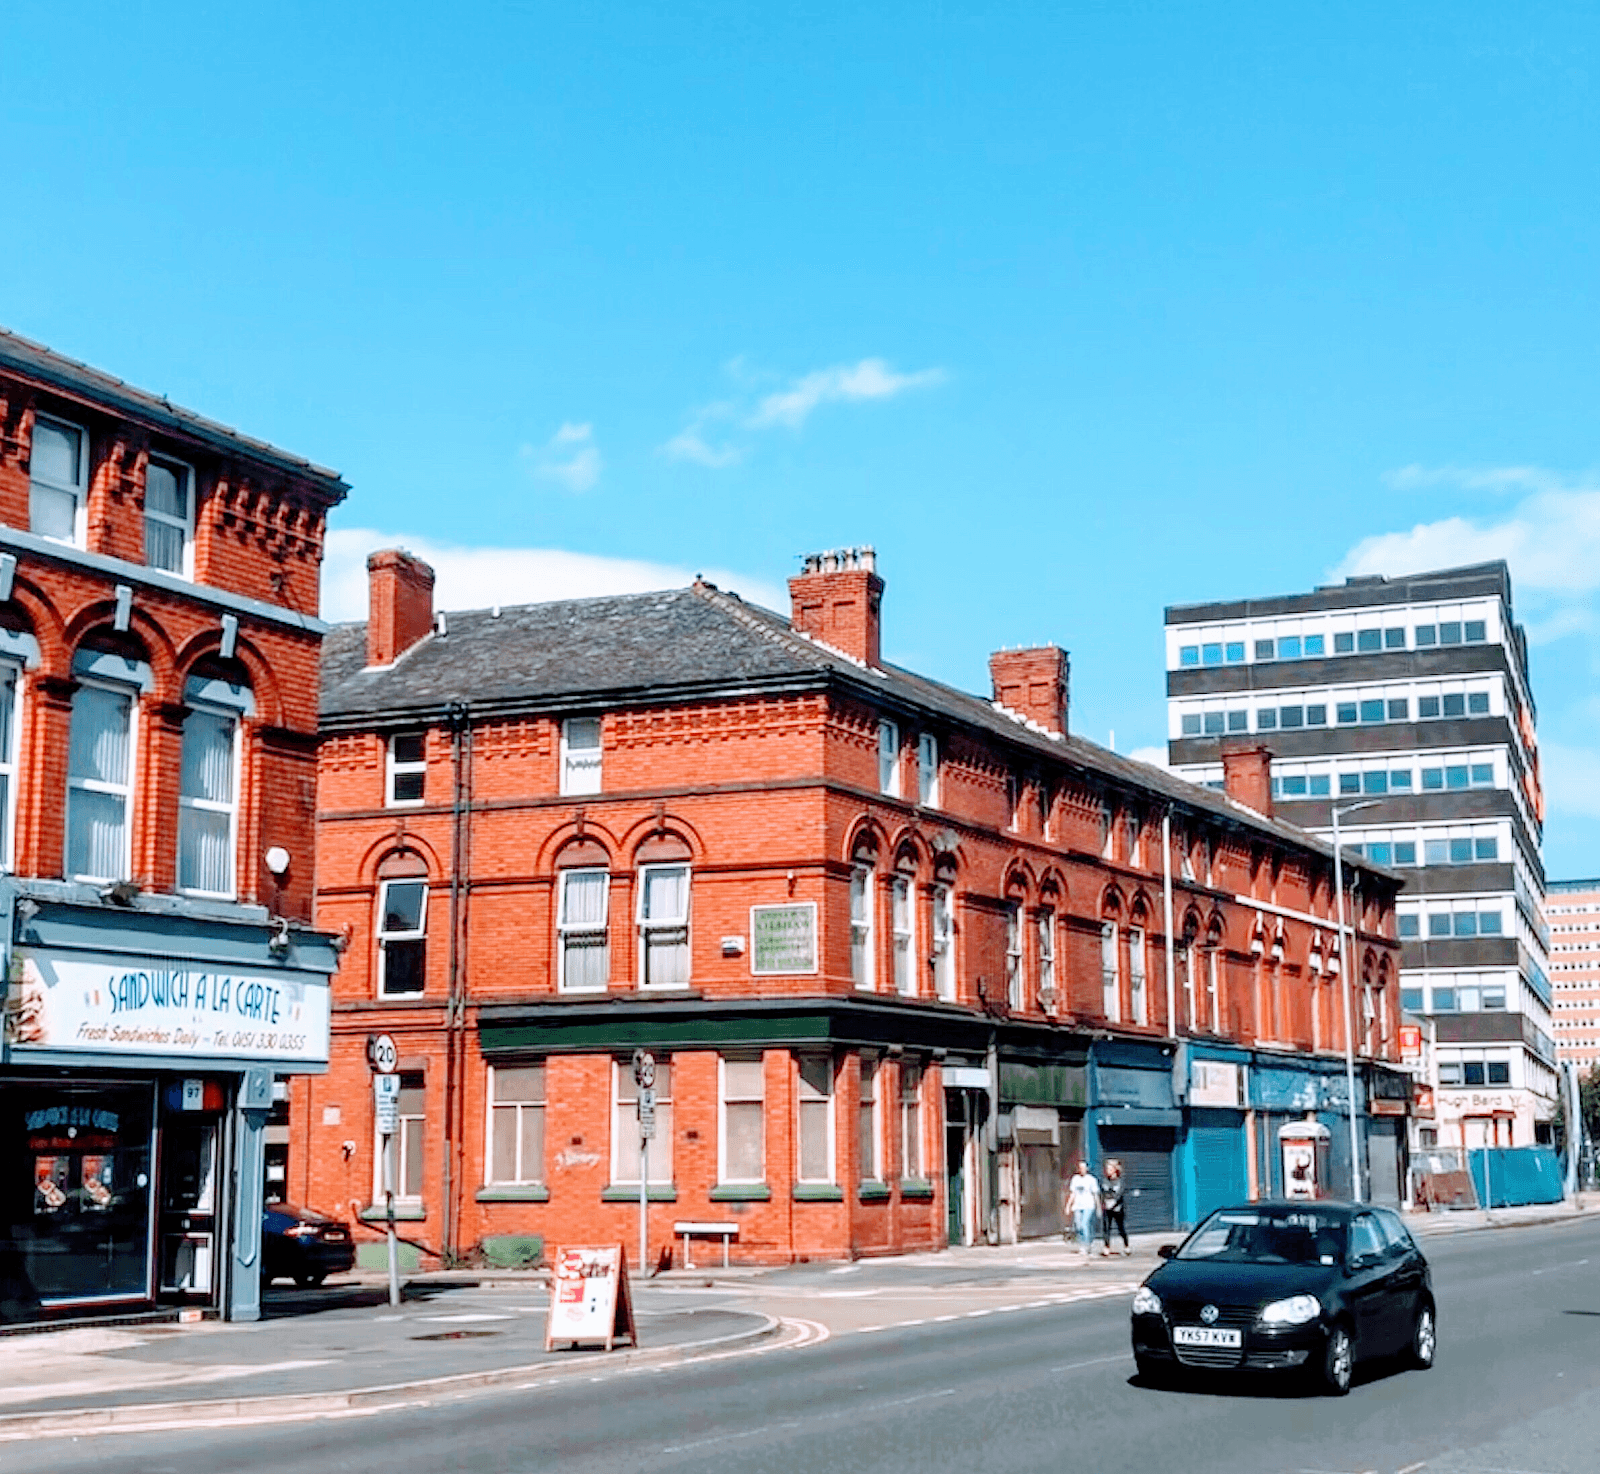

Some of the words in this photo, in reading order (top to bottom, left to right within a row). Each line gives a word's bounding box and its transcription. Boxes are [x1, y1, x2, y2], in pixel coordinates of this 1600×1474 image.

[109, 970, 189, 1014] SANDWICH
[195, 974, 206, 1010] A
[212, 974, 231, 1013] LA
[236, 981, 280, 1024] CARTE
[76, 1021, 108, 1040] Fresh
[109, 1024, 170, 1044] Sandwiches
[172, 1027, 200, 1049] Daily
[256, 1032, 278, 1049] 330
[279, 1033, 306, 1050] 0355
[377, 1045, 394, 1063] 20
[186, 1086, 200, 1098] 97
[1180, 1329, 1209, 1342] YK57
